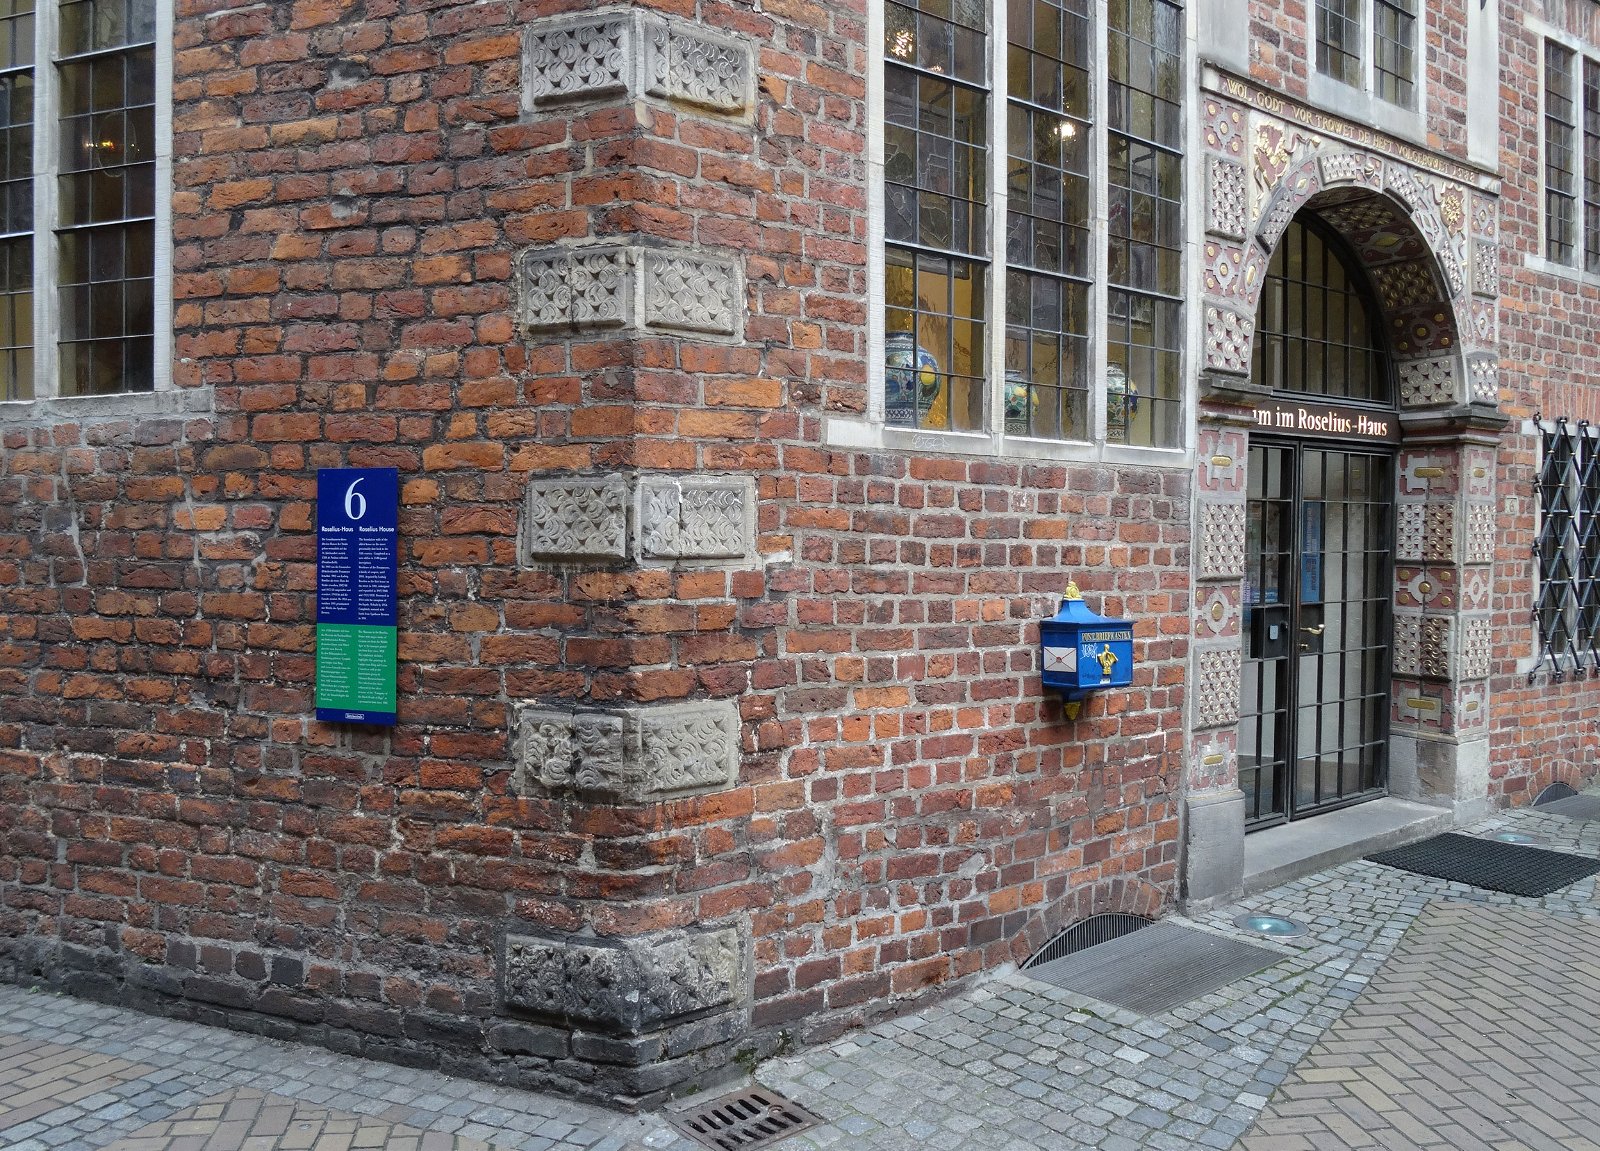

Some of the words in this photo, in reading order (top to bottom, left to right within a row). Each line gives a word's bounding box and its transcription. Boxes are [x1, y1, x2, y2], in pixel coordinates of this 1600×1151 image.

[1256, 91, 1286, 114] GODT
[1275, 406, 1295, 429] im
[1298, 408, 1388, 437] Roselius-Haus
[344, 477, 367, 520] 6
[321, 525, 354, 533] Roselius-Haus
